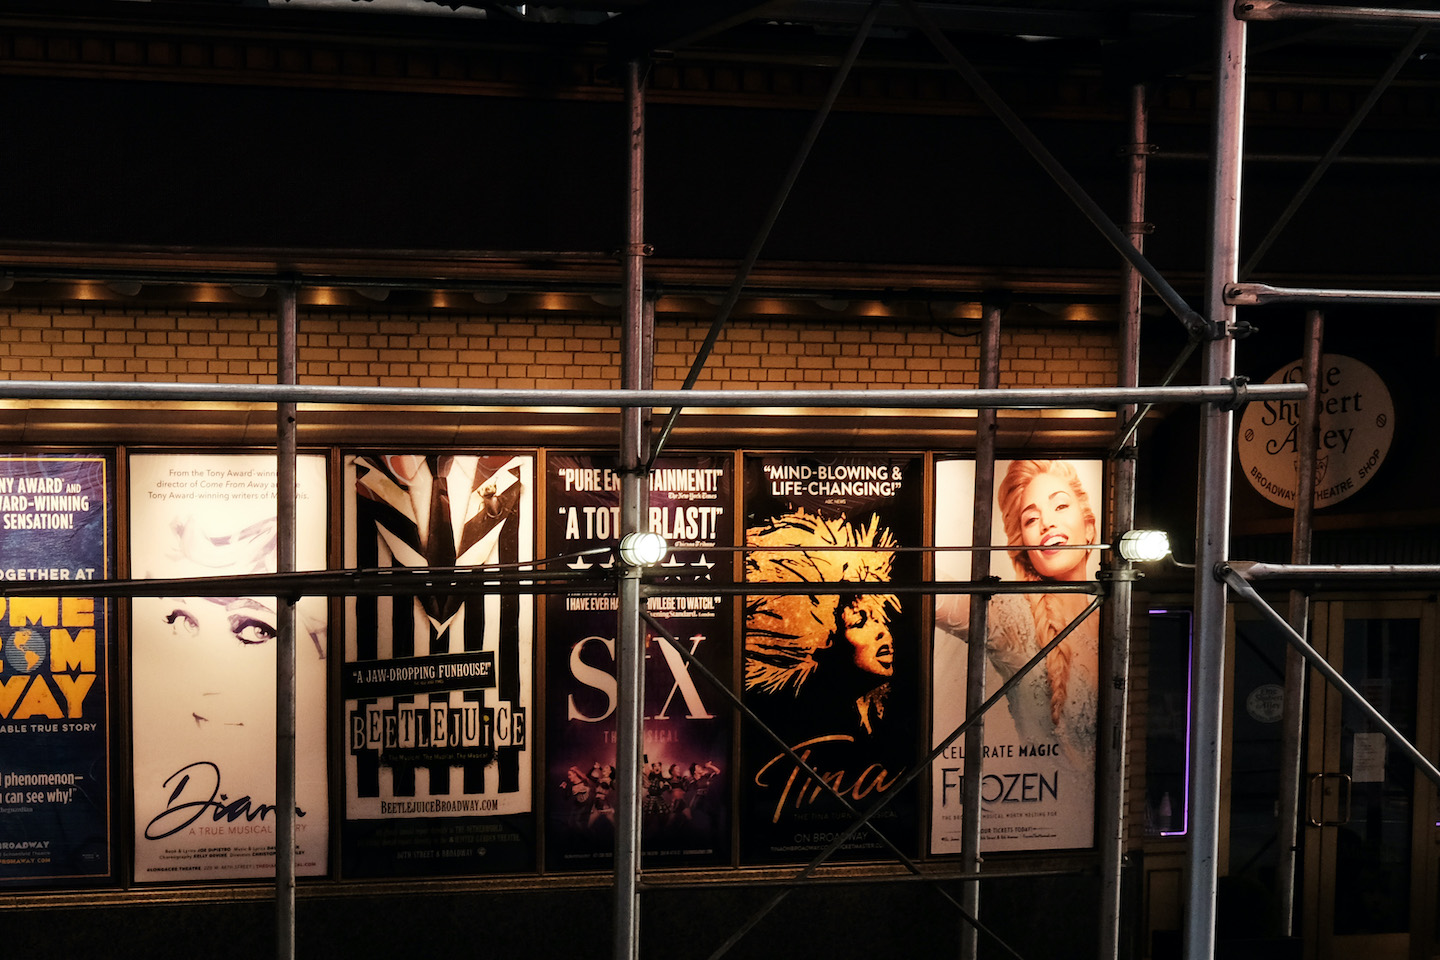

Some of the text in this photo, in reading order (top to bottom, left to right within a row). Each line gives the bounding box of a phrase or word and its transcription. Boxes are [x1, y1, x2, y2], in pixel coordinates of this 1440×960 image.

[1266, 424, 1355, 455] Aley
[169, 469, 190, 477] From
[191, 469, 205, 477] the
[206, 469, 225, 478] Tony
[604, 469, 723, 491] ENTAINMENT!”
[892, 466, 903, 480] &
[1250, 466, 1297, 501] BROADWAY
[1358, 448, 1381, 479] SHOP
[66, 483, 82, 493] AND
[247, 481, 269, 490] Away
[148, 491, 167, 501] Tony
[168, 492, 230, 501] Award-winning
[261, 492, 269, 500] of
[4, 513, 73, 529] SENSATION!
[583, 507, 621, 539] TOT
[75, 568, 95, 580] AT
[566, 598, 570, 610] I
[570, 598, 590, 610] HAVE
[591, 597, 610, 610] EVER
[676, 597, 686, 609] TO
[366, 665, 436, 682] JAW-DROPPING
[568, 636, 717, 722] SX
[31, 724, 59, 733] TRUE
[62, 723, 97, 732] STORY
[604, 729, 679, 743] TH SICAL
[943, 744, 1059, 759] CELRATE MAGIC
[755, 734, 907, 824] Tina
[941, 767, 1059, 808] FOZEN
[5, 791, 24, 804] can
[26, 790, 45, 803] see
[144, 761, 307, 840] Dian
[188, 825, 273, 836] A TRUE MUSICAL
[794, 831, 869, 843] ON BROAWAY
